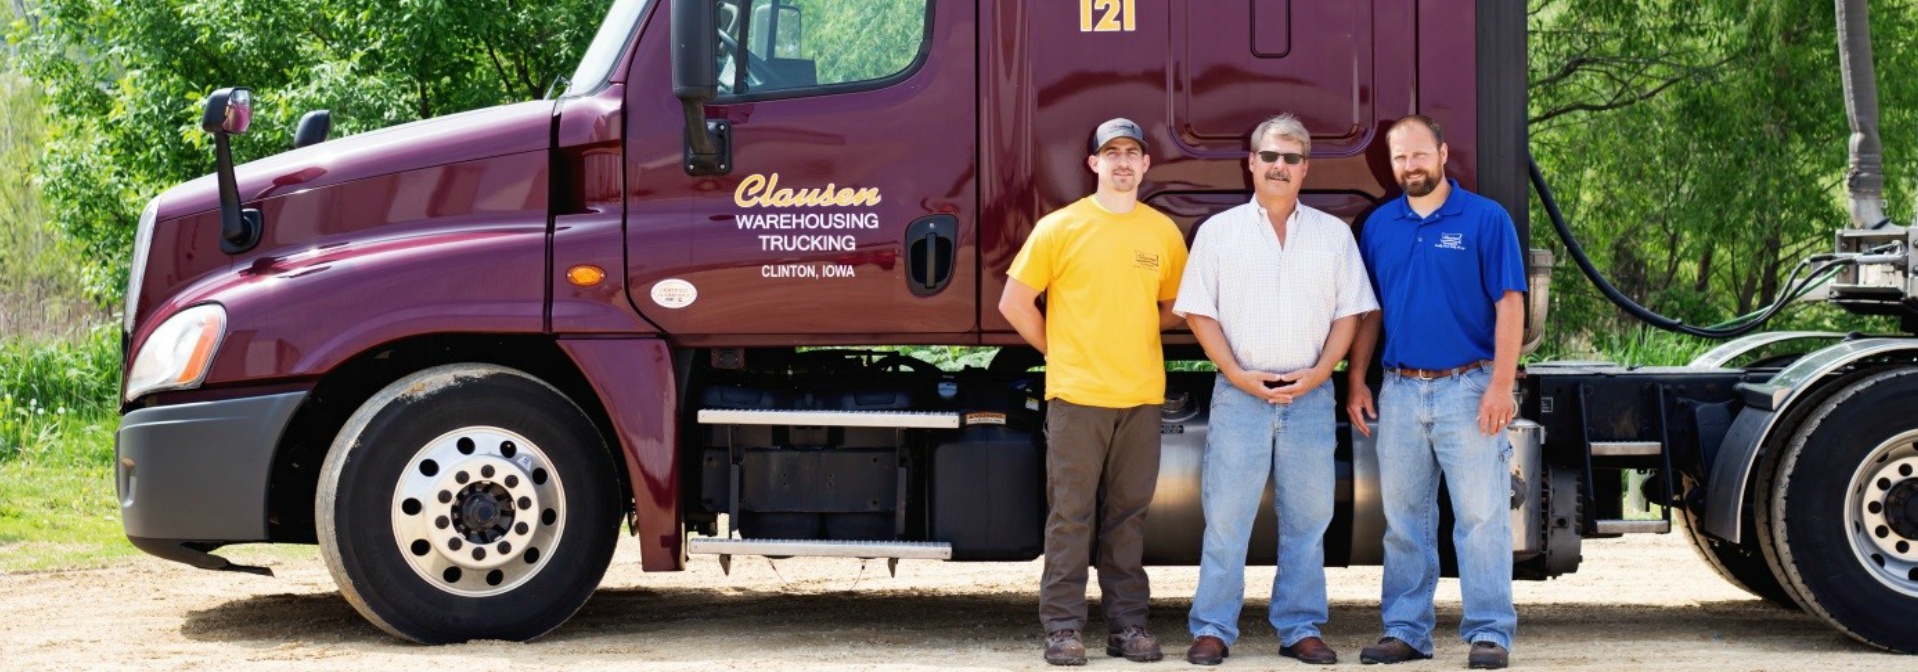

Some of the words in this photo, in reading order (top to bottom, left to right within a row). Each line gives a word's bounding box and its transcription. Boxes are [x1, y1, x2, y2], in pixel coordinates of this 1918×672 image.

[1080, 0, 1136, 32] 121
[734, 173, 881, 207] Clausen
[735, 213, 879, 229] WAREHOUSING
[758, 235, 856, 251] TRUCKING
[761, 264, 819, 279] CLINTON,
[822, 264, 855, 278] IOWA
